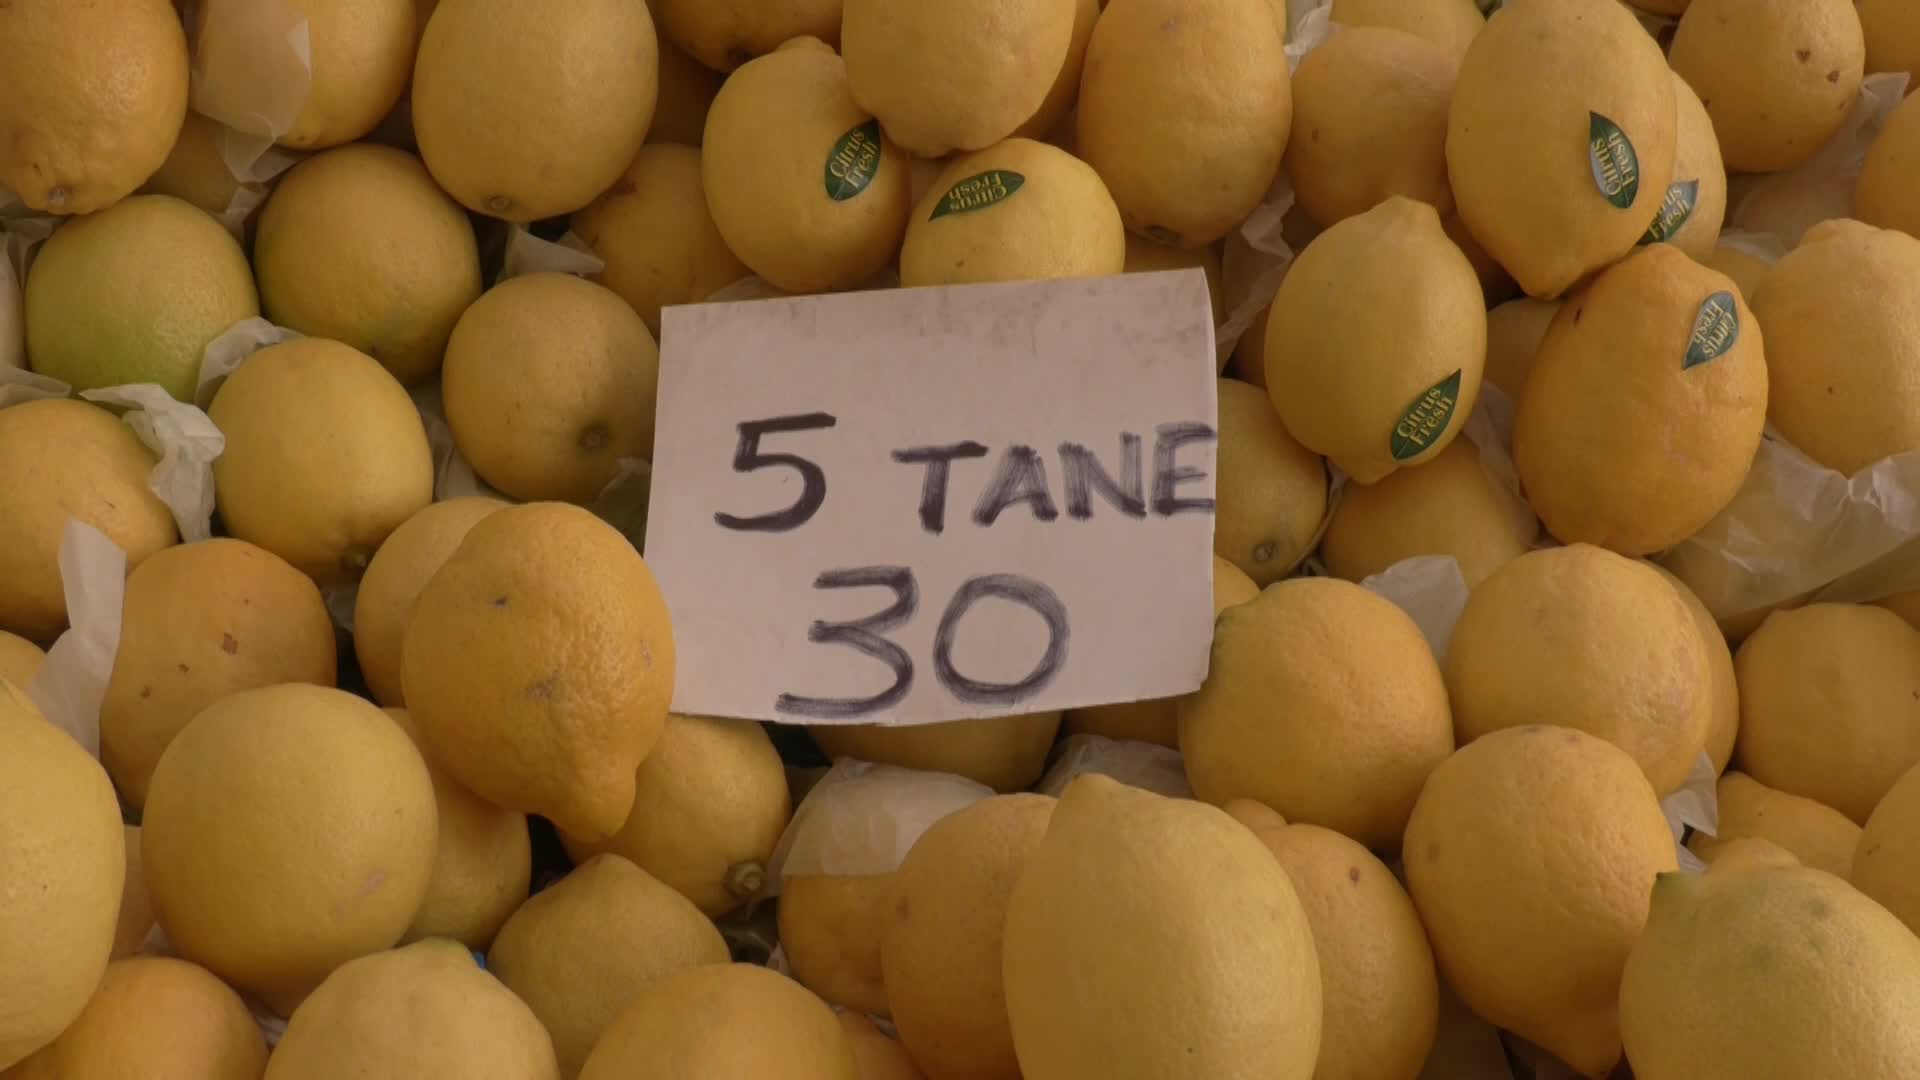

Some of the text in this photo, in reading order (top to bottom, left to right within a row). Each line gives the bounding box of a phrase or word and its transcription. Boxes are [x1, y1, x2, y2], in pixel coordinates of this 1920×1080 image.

[830, 129, 865, 177] Citrus
[844, 142, 879, 189] Fresh
[1593, 137, 1621, 195] Citrus
[1607, 132, 1635, 187] Fresh
[1694, 299, 1724, 343] Fresh
[1702, 311, 1736, 356] Citrus
[1397, 388, 1441, 437] Citrus
[1409, 397, 1453, 446] Fresh
[714, 411, 1217, 535] 5 TANE
[775, 564, 1070, 719] 30
